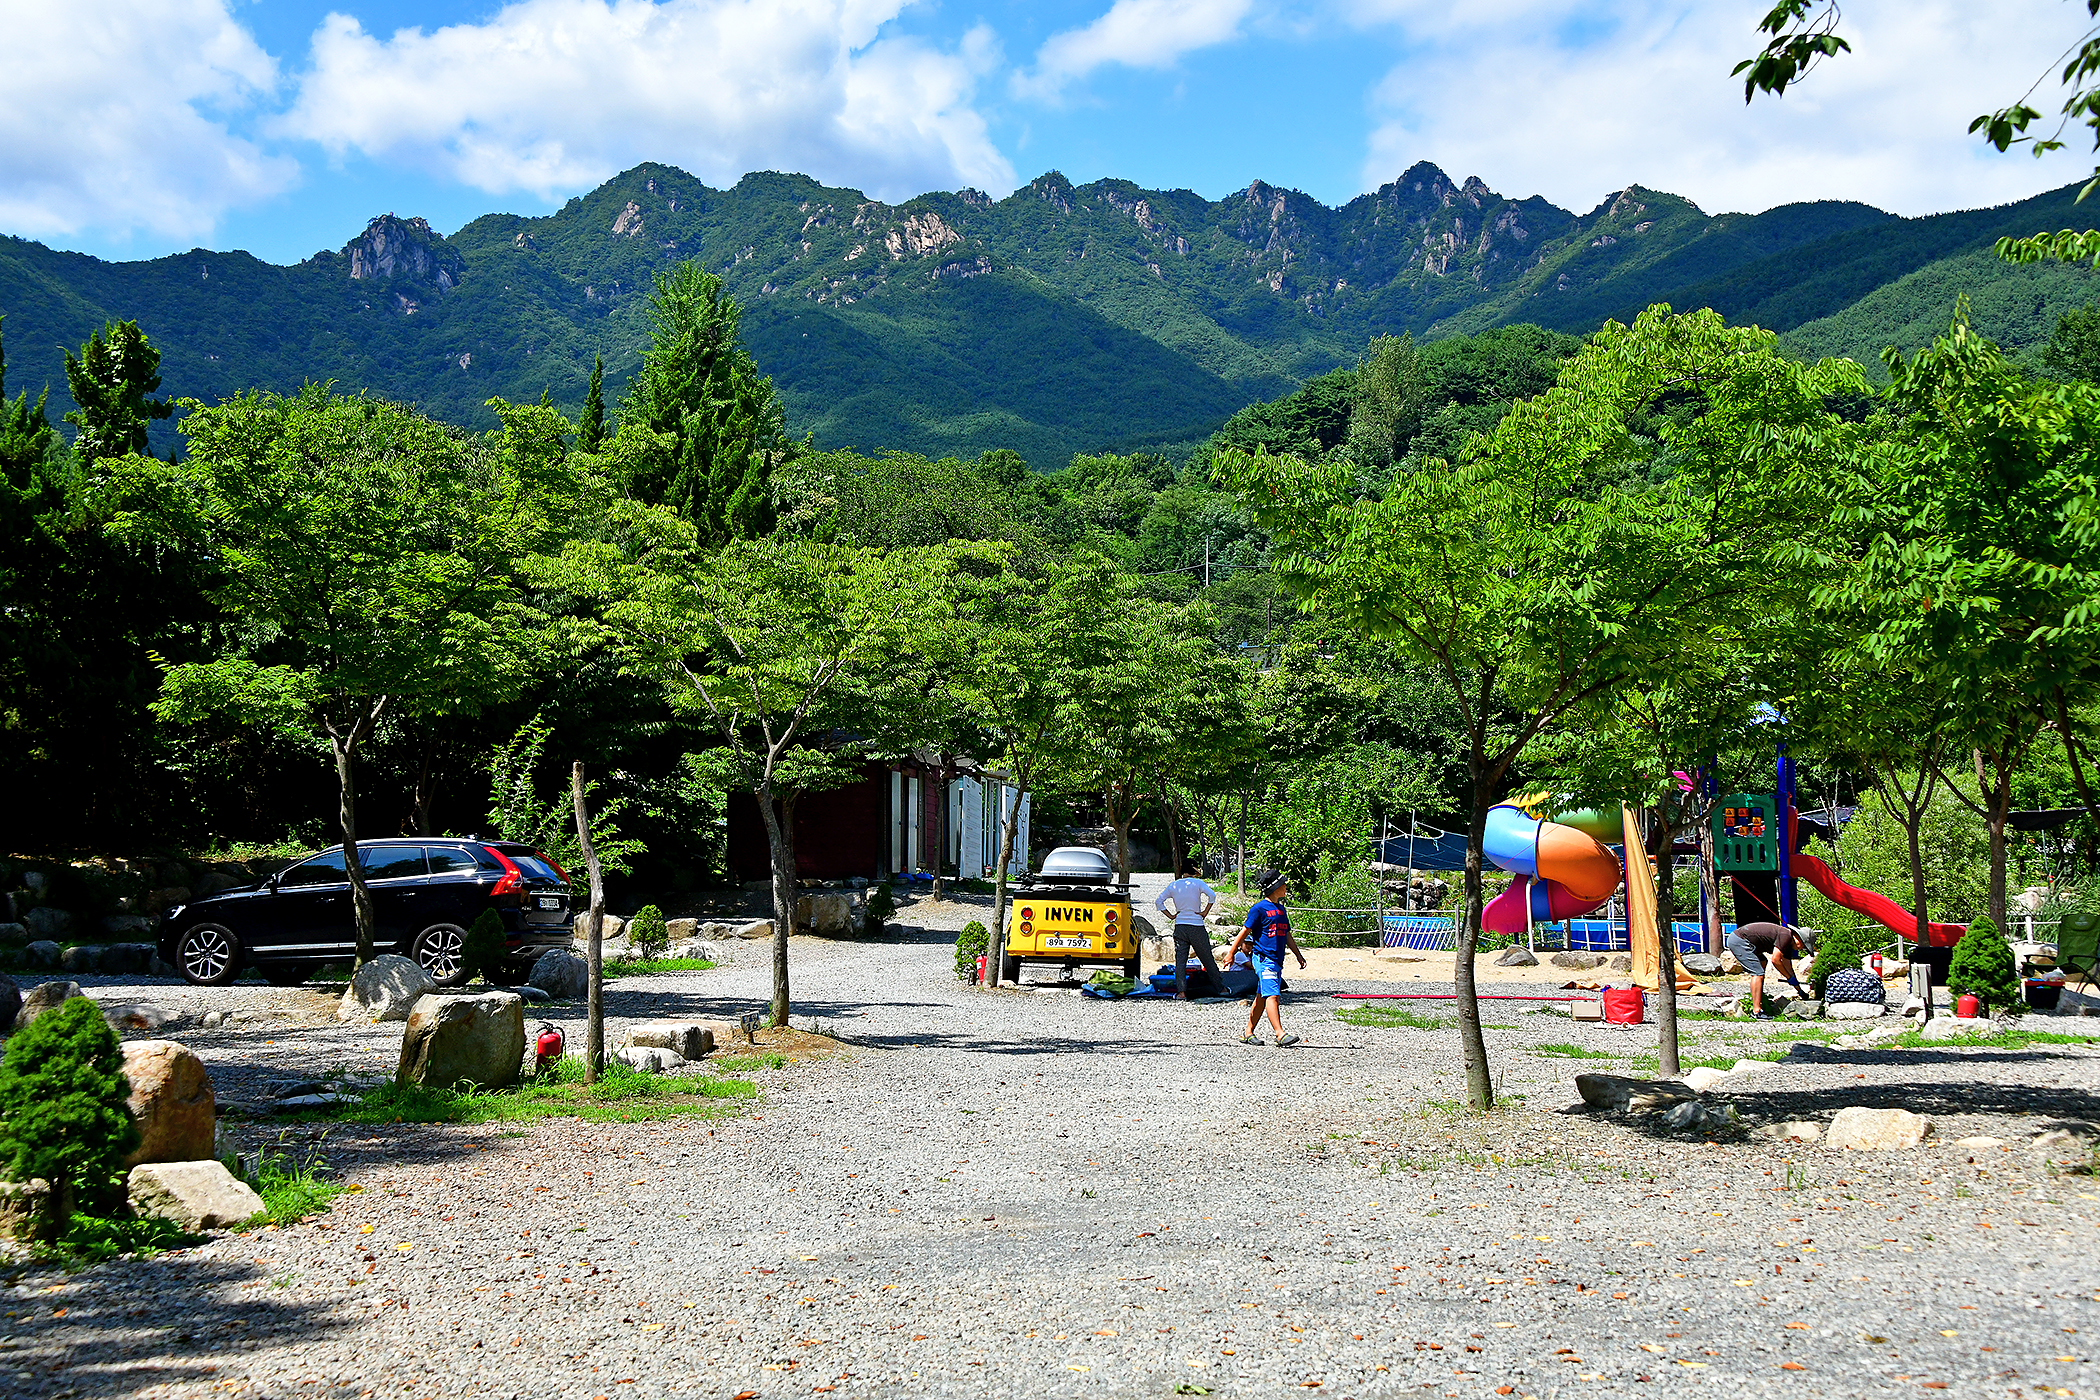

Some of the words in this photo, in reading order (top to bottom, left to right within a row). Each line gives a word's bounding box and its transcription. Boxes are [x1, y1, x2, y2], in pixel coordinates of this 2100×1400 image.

[1045, 907, 1093, 922] INVEN
[1067, 939, 1087, 948] 7592
[746, 1021, 758, 1031] 16
